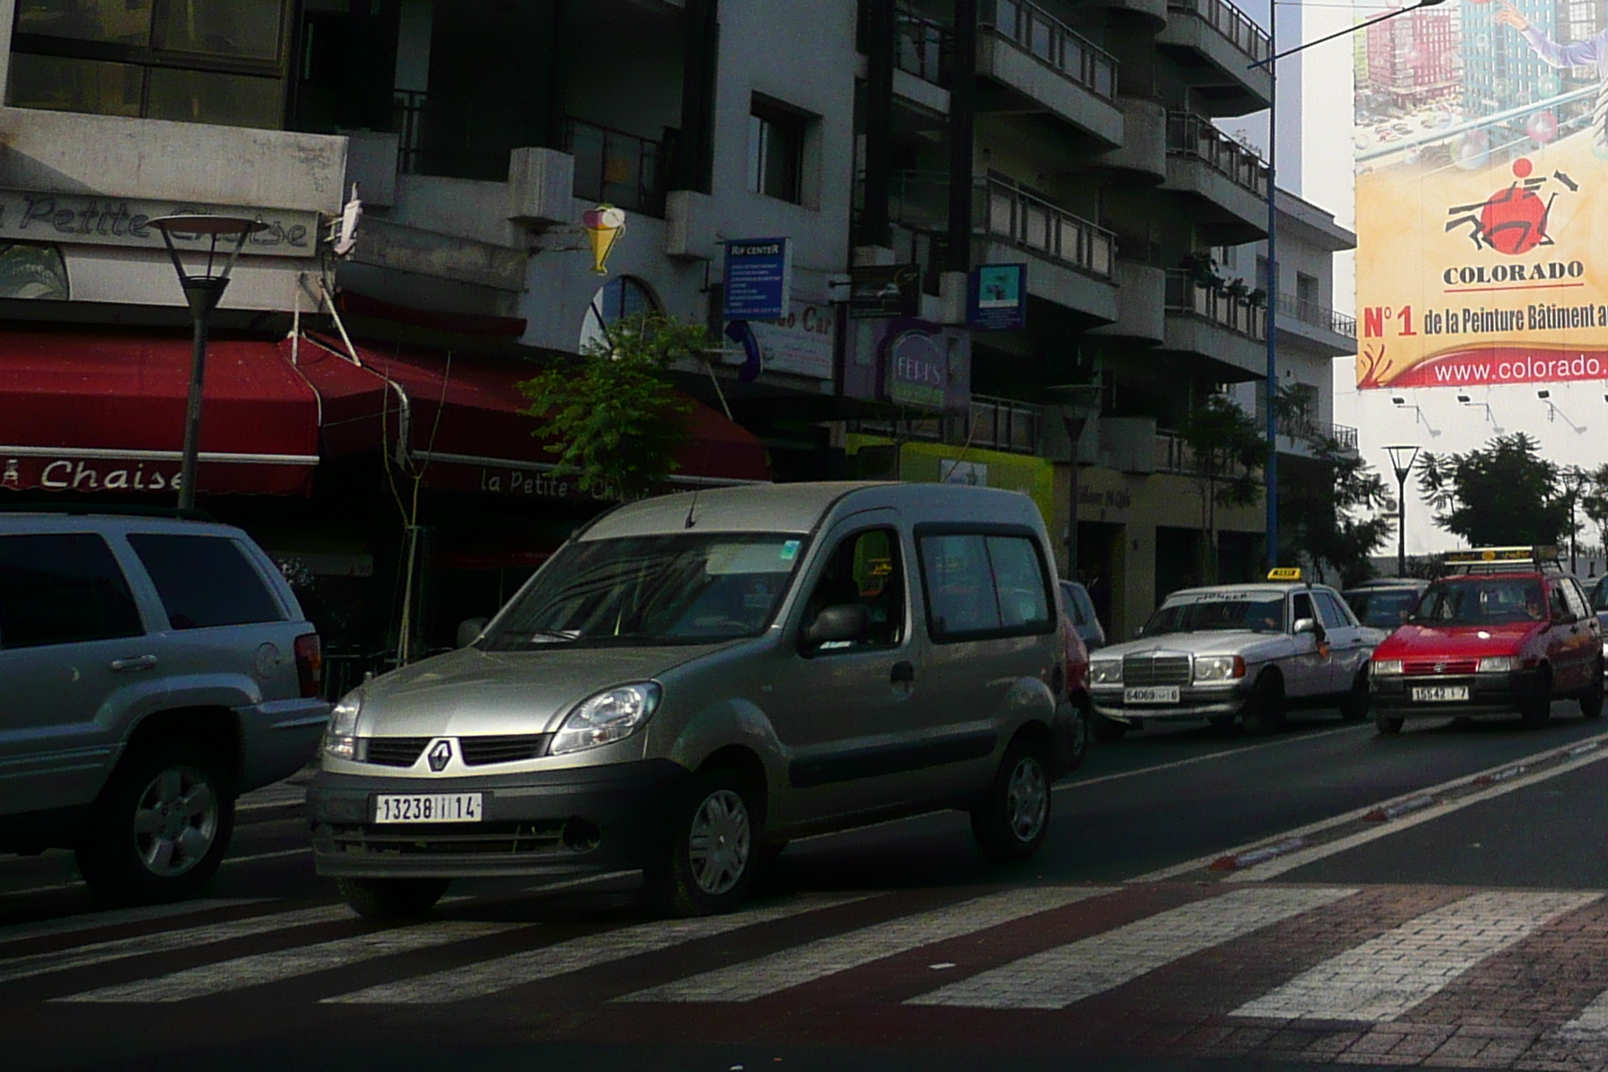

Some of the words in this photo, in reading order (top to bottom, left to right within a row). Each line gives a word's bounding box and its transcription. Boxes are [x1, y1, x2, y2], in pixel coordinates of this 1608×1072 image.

[746, 244, 779, 255] CENTER
[1443, 260, 1584, 285] COLORADO
[1397, 305, 1417, 337] 1
[1424, 309, 1442, 335] de
[1444, 308, 1460, 334] la
[1462, 304, 1524, 334] Peinture
[1527, 302, 1595, 331] Bâtiment
[41, 460, 182, 490] Chaise
[510, 471, 568, 497] Petite
[384, 798, 432, 820] 13238
[456, 796, 475, 819] 14
